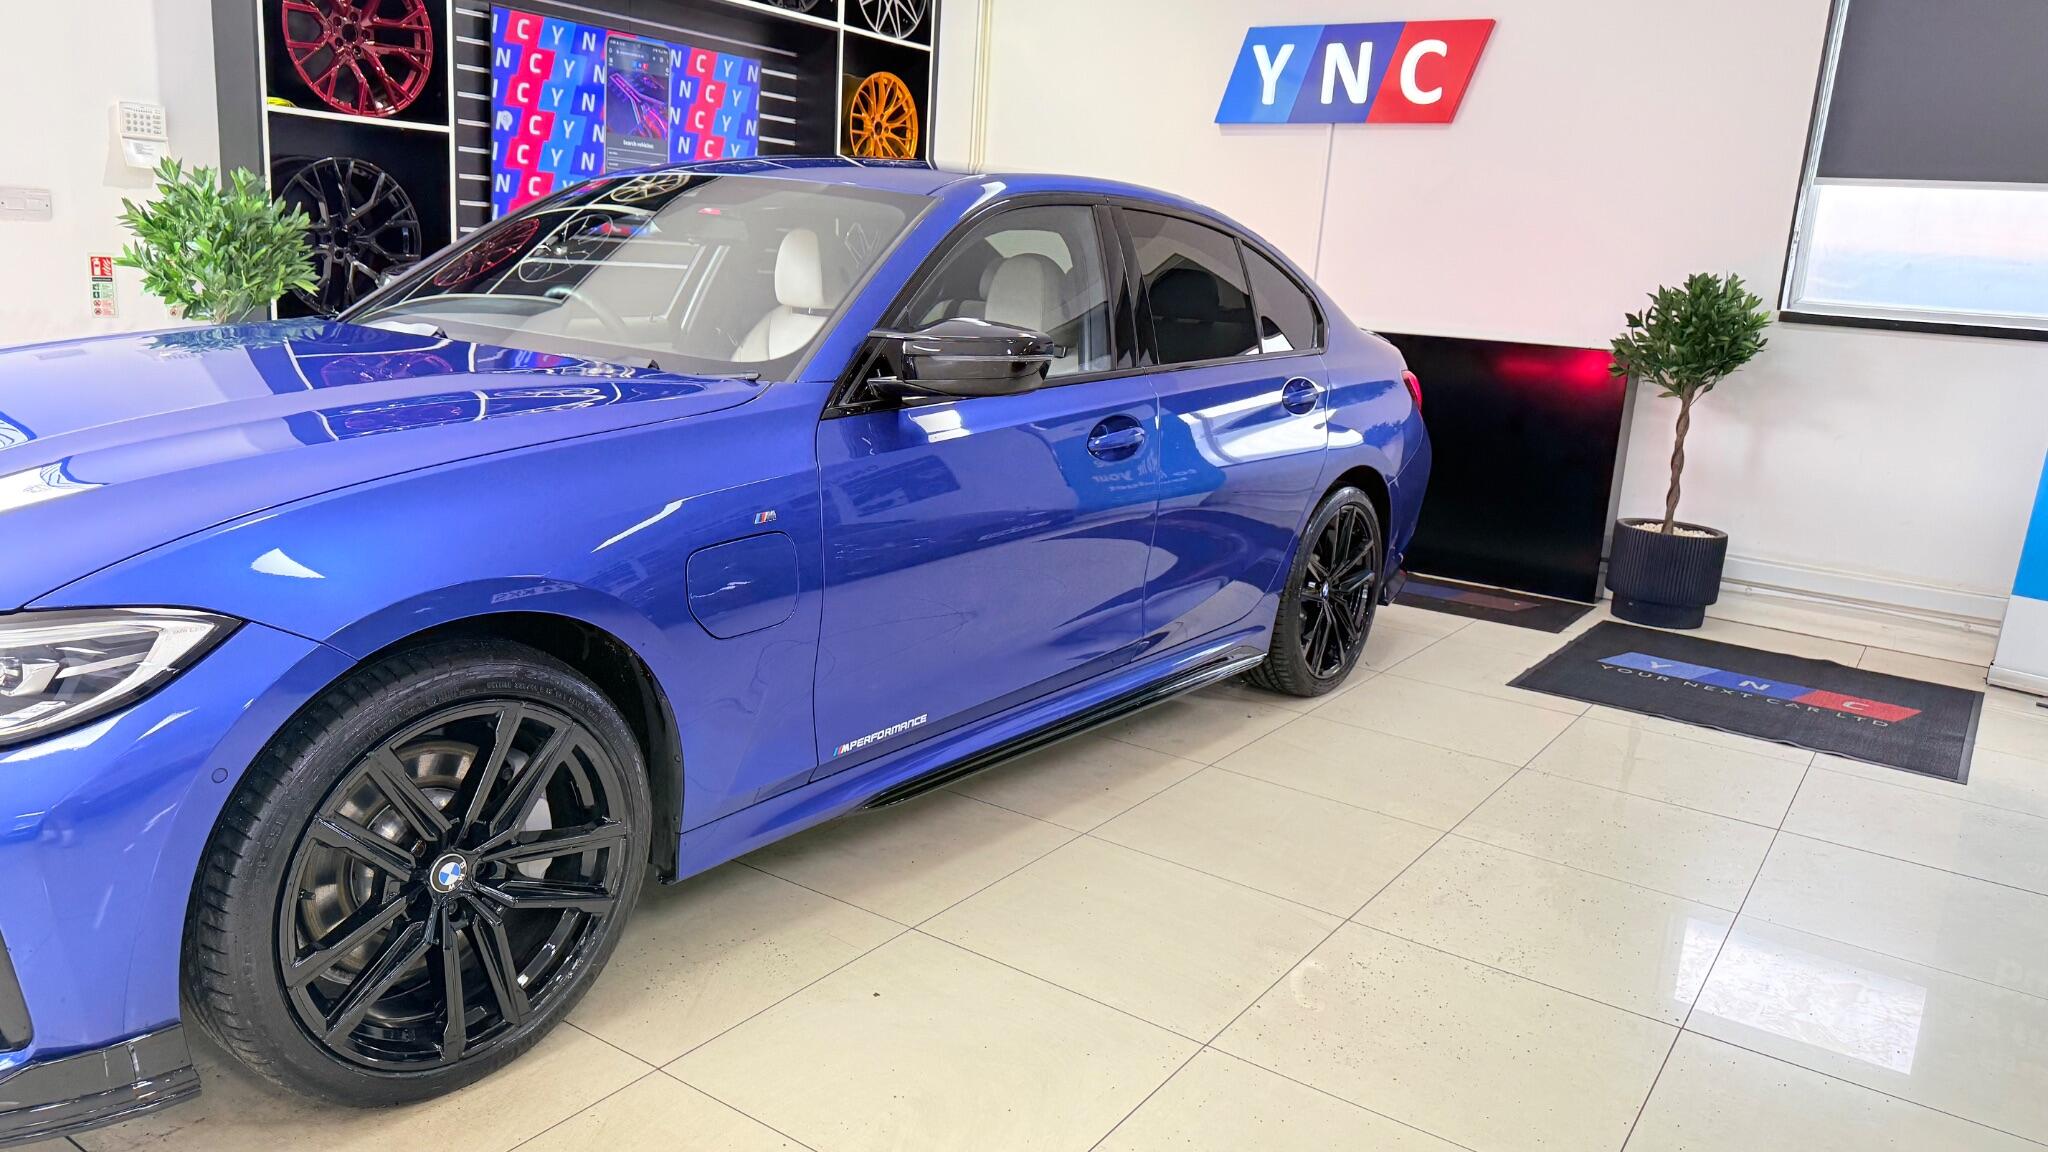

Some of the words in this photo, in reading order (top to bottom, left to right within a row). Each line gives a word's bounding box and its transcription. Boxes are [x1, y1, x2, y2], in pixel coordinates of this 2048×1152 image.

[1253, 39, 1447, 104] YNC
[1601, 664, 1669, 682] YOUR
[1683, 681, 1752, 698] NEXT
[1766, 698, 1819, 713] CAR
[1836, 712, 1889, 727] LTD
